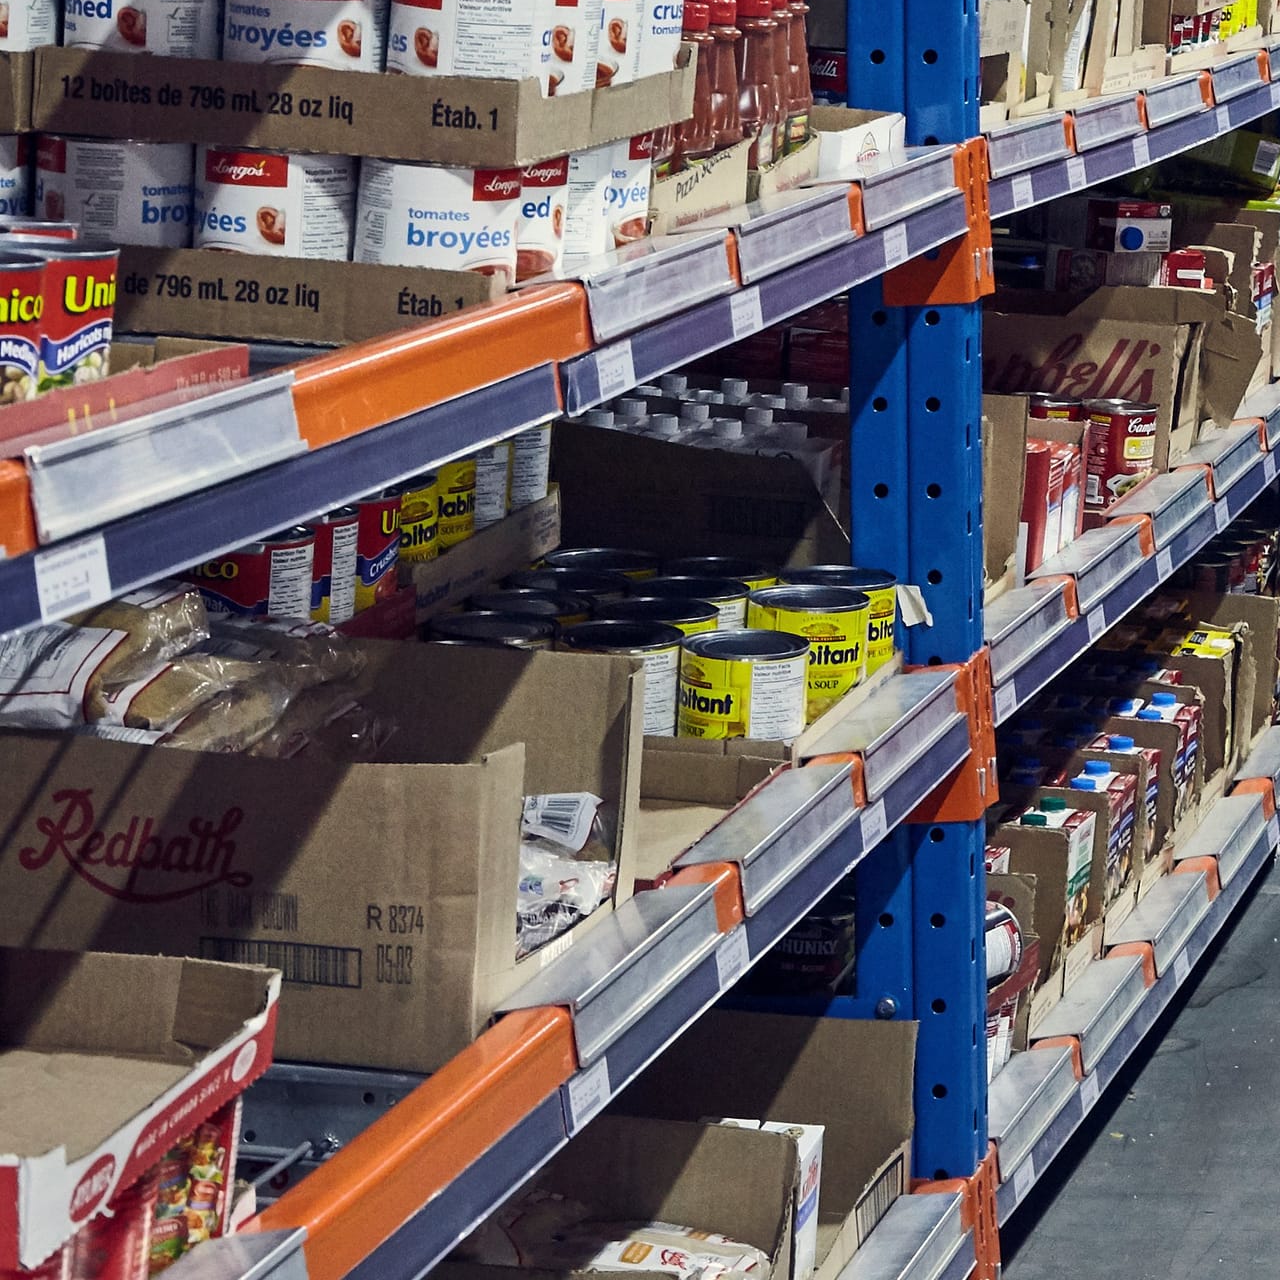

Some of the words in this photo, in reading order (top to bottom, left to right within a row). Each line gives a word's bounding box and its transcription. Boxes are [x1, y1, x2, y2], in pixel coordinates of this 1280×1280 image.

[459, 2, 482, 12] Valeur
[484, 4, 512, 13] nutritive
[229, 23, 328, 51] broyées
[62, 75, 85, 97] 12
[91, 77, 151, 104] boîtes
[158, 84, 182, 106] de
[190, 85, 225, 110] 796
[232, 90, 261, 113] mL
[268, 92, 292, 115] 28
[299, 100, 321, 117] oz
[328, 95, 354, 124] liq
[432, 98, 481, 130] Étab.
[489, 108, 499, 130] 1
[212, 161, 264, 179] Longo's
[676, 172, 699, 202] PIZZA
[408, 207, 470, 222] tomates
[407, 223, 510, 254] broyées
[125, 273, 148, 295] de
[156, 275, 192, 298] 796
[199, 277, 227, 301] mL
[235, 280, 259, 301] 28
[266, 285, 288, 305] oz
[295, 284, 319, 312] liq
[398, 288, 447, 315] Étab.
[57, 327, 103, 366] Haricots
[815, 680, 838, 689] SOUP
[19, 788, 248, 896] Redpath
[367, 905, 382, 931] R
[388, 904, 424, 933] 8374
